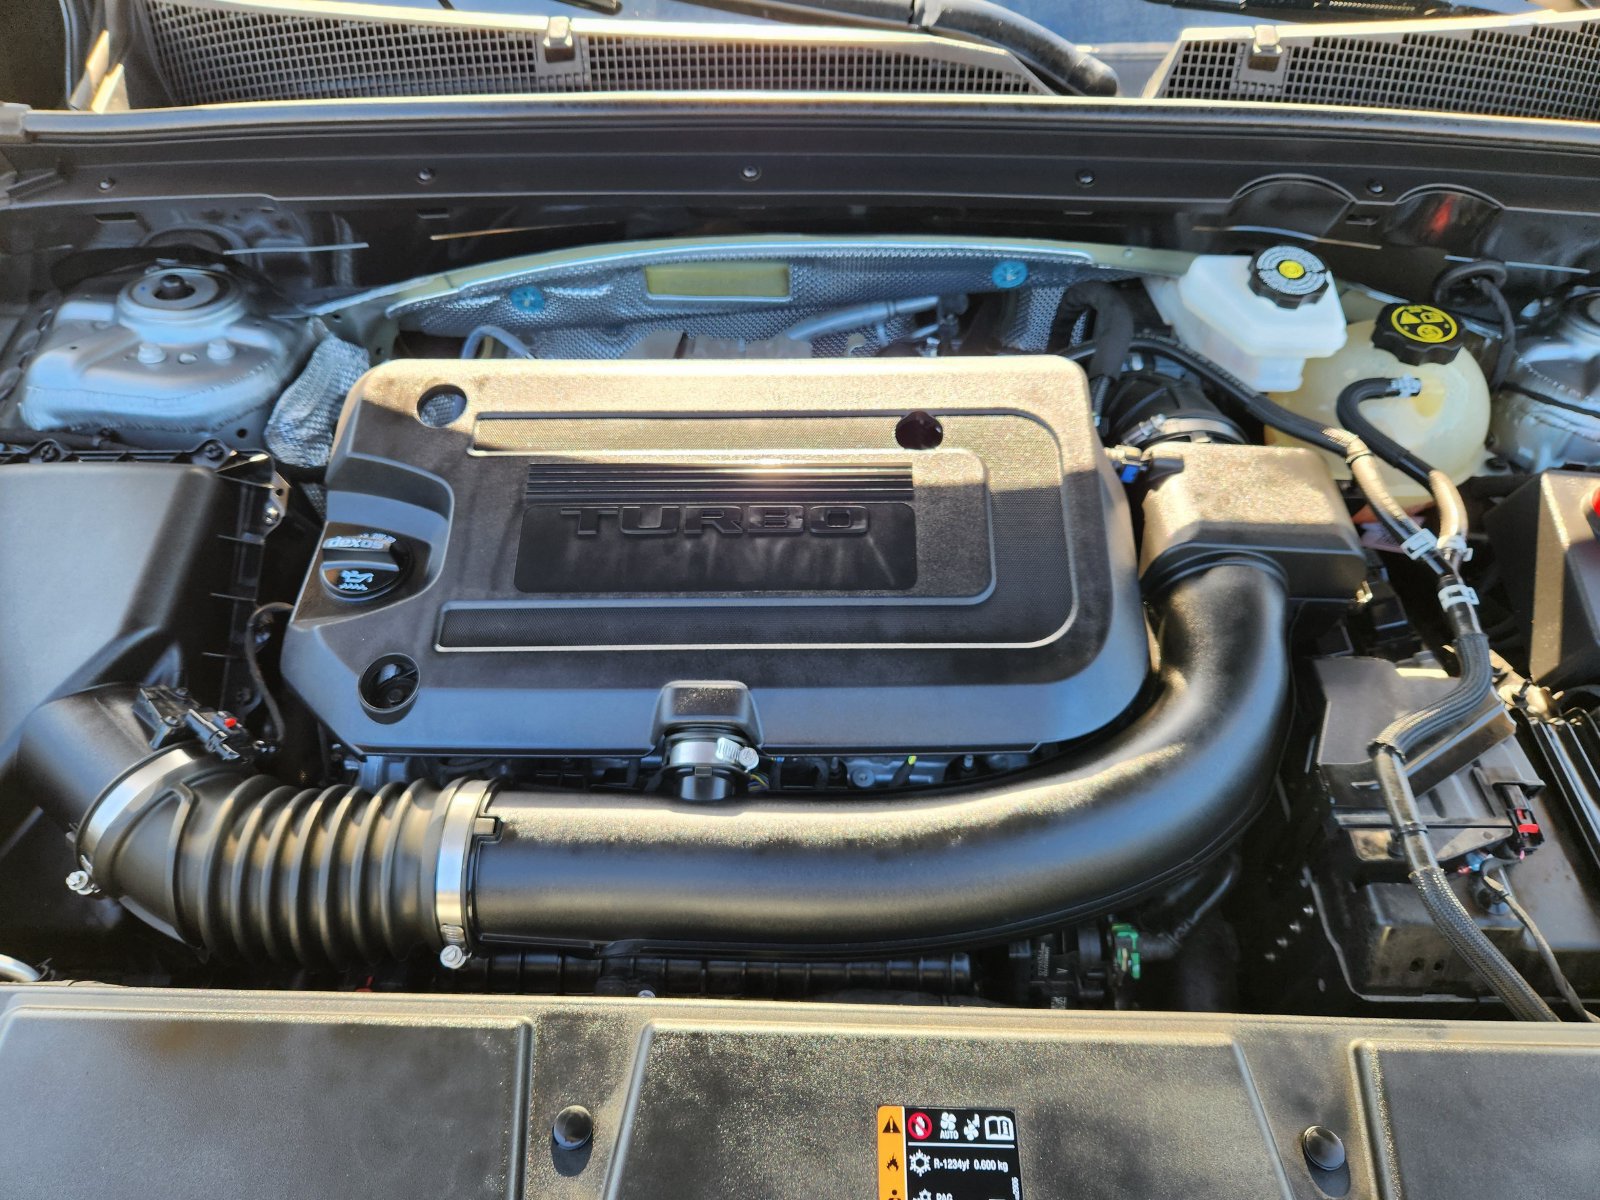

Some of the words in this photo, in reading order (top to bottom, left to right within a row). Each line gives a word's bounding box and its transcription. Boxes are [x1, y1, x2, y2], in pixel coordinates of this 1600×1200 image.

[560, 505, 870, 535] TURBO
[939, 1130, 959, 1140] AUTO
[934, 1158, 970, 1171] R-1234yf
[997, 1160, 1009, 1173] kg
